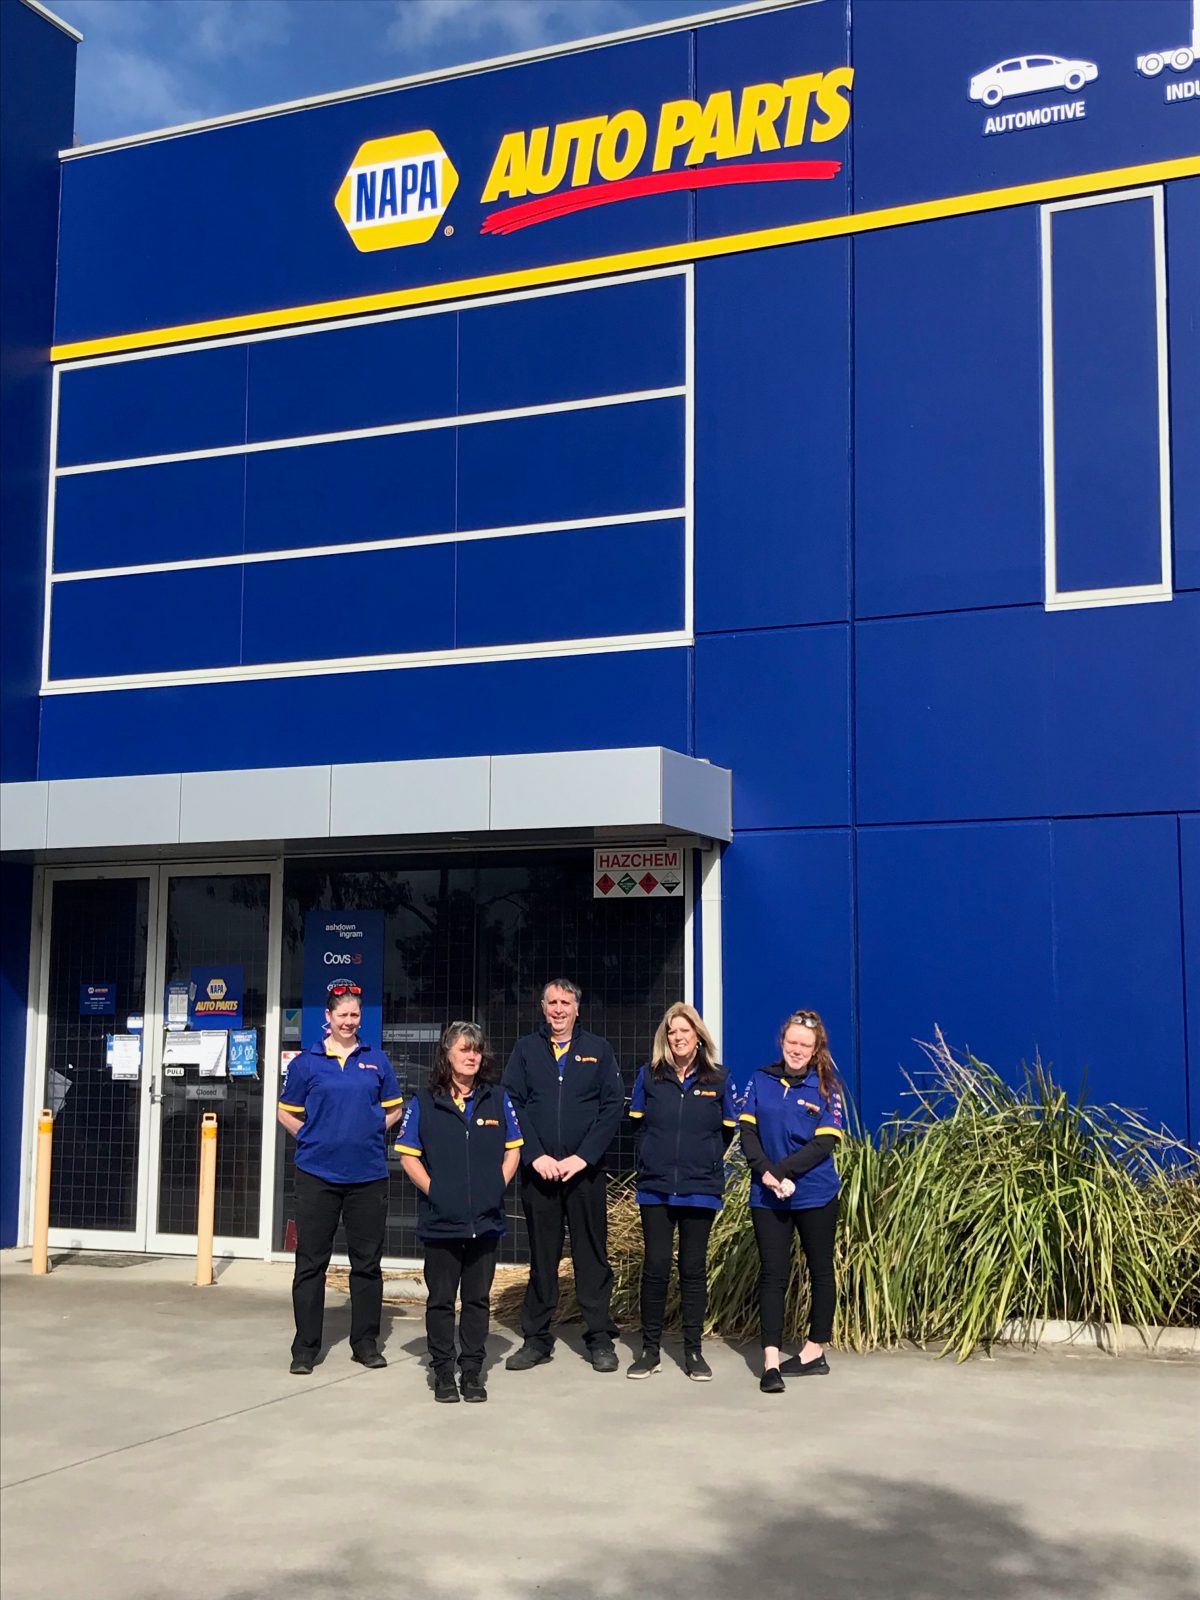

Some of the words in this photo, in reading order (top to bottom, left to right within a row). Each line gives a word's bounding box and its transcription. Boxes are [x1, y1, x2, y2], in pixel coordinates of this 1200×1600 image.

[984, 101, 1086, 134] AUTOMOTIVE
[480, 109, 647, 203] AUTO
[652, 67, 854, 172] PARTS
[356, 159, 438, 223] NAPA
[599, 852, 678, 868] HAZCHEM
[325, 923, 356, 931] ashdown
[339, 931, 363, 939] ingram
[323, 951, 352, 965] Covs
[210, 984, 225, 994] NAPA
[195, 1001, 215, 1011] AUTO
[215, 1000, 239, 1011] PARTS
[166, 1067, 183, 1075] PULL
[195, 1088, 218, 1096] Closed
